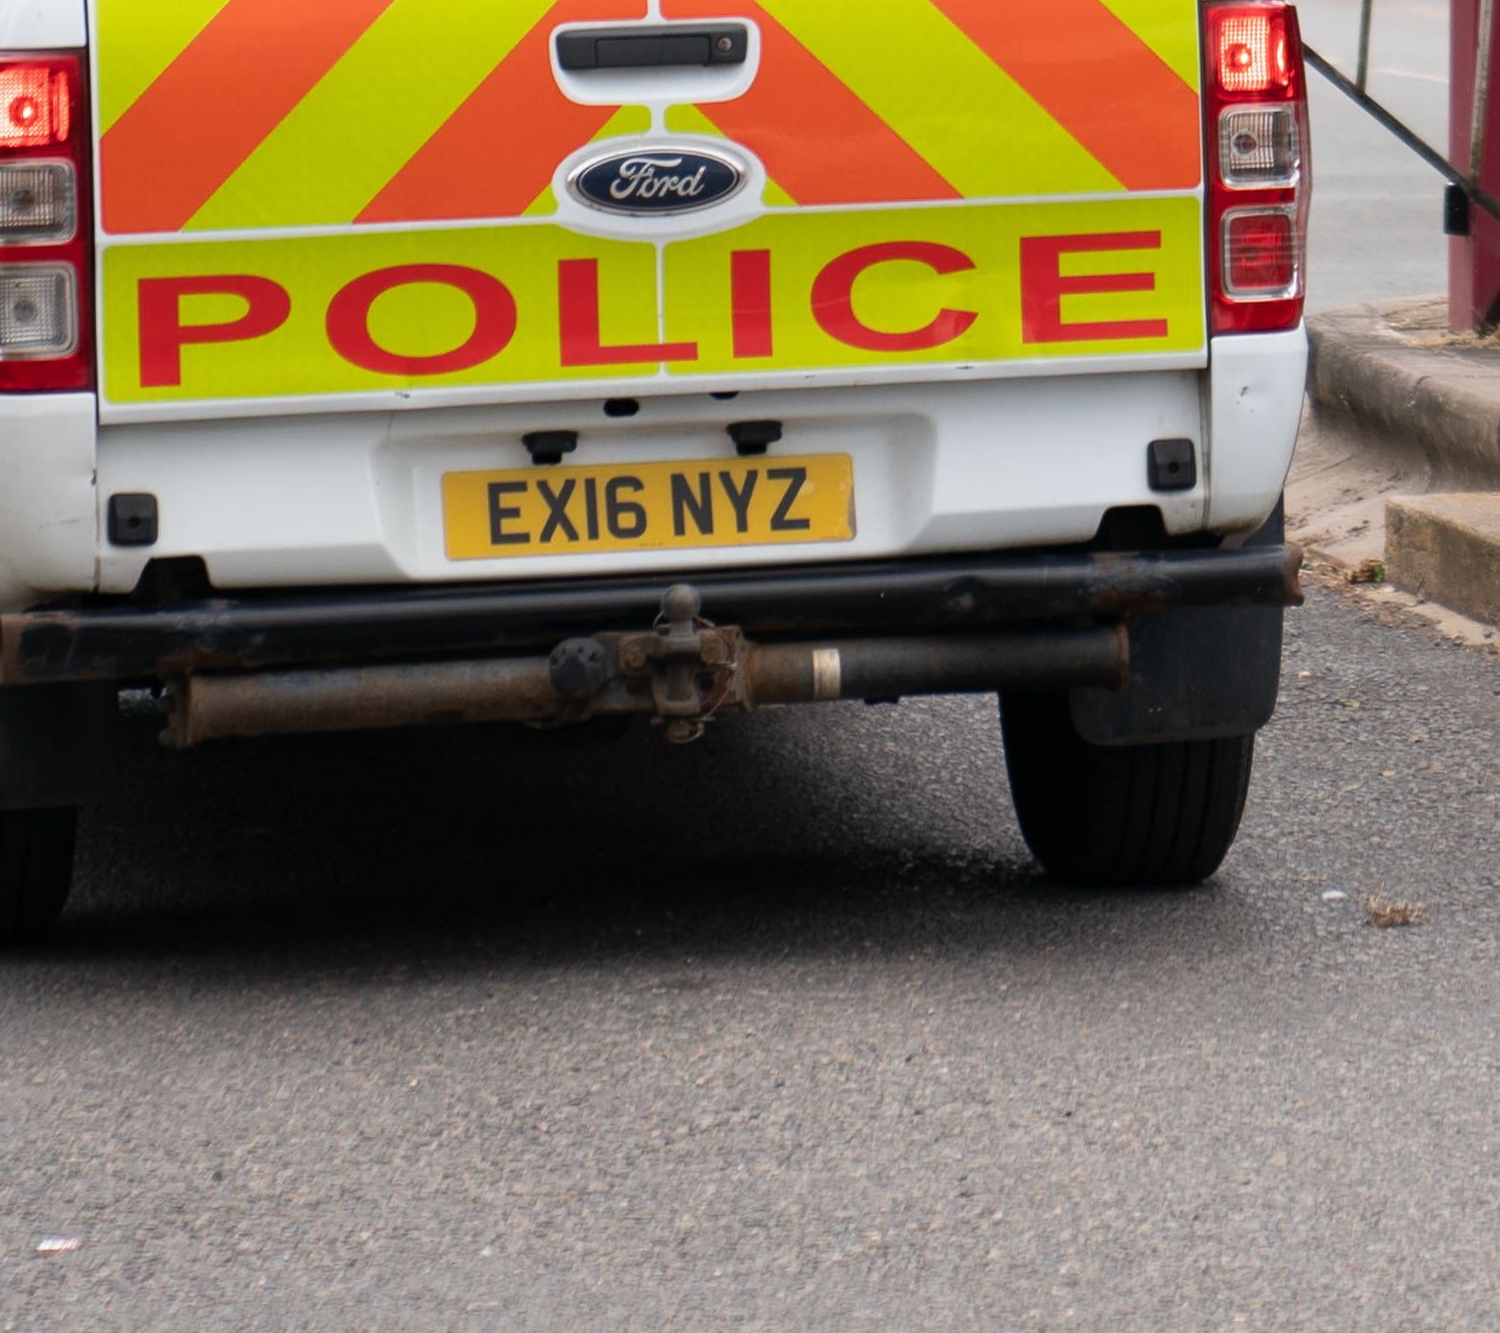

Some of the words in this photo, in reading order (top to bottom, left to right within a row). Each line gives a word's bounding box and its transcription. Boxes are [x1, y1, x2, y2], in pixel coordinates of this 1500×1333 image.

[609, 157, 706, 199] Ford
[137, 229, 1169, 389] POLICE
[486, 475, 648, 547] EX16
[670, 467, 811, 537] NYZ
